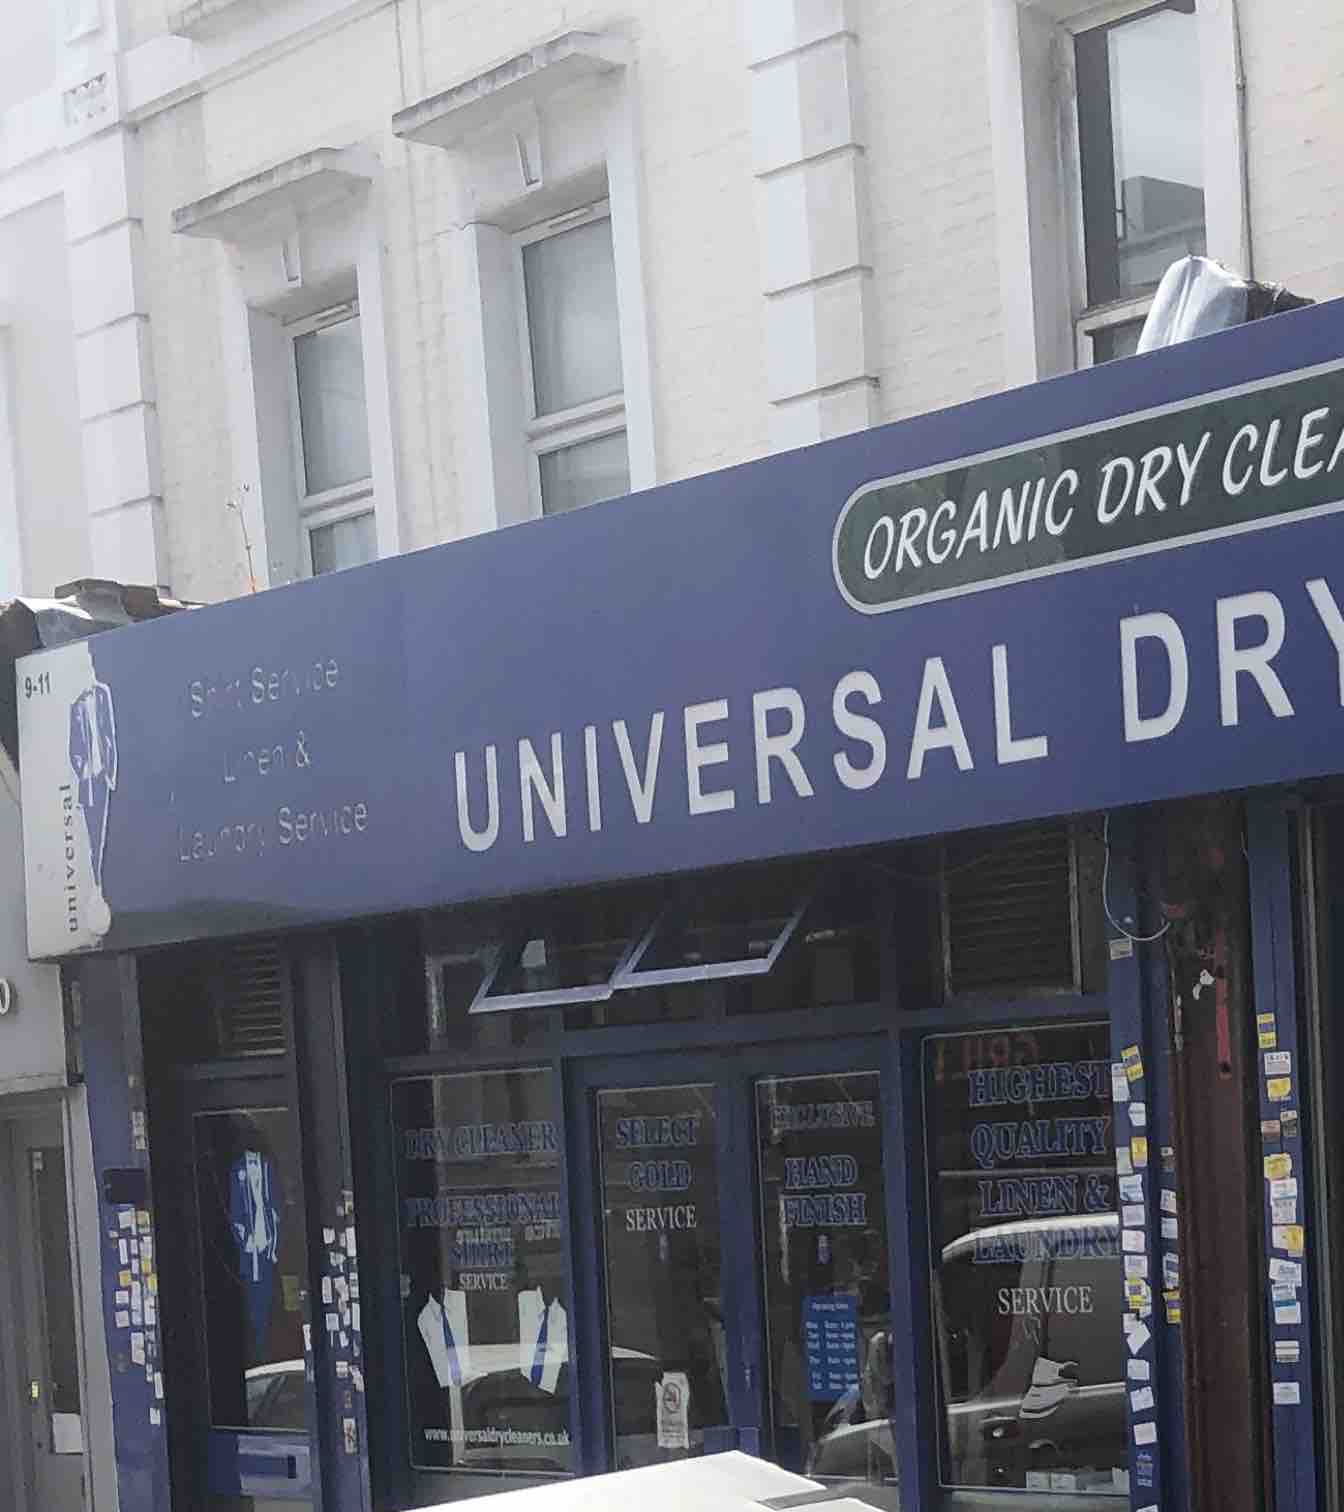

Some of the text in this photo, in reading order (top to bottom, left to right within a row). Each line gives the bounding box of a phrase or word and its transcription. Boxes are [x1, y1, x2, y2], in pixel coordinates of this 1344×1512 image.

[863, 468, 1079, 582] ORGANIC
[1096, 433, 1211, 524] DRY
[25, 672, 52, 698] 9-11
[252, 658, 340, 704] Serce
[453, 643, 1049, 853] UNIVERSAL
[279, 800, 368, 845] Service
[59, 784, 79, 932] universal
[968, 1061, 1113, 1108] HIGHEST
[970, 1116, 1111, 1169] QUALITY
[784, 1153, 857, 1189] HAND
[625, 1205, 698, 1232] SERVICE
[978, 1175, 1080, 1217] LINEN
[458, 1272, 509, 1291] SERVICE
[997, 1285, 1094, 1315] SERVICE
